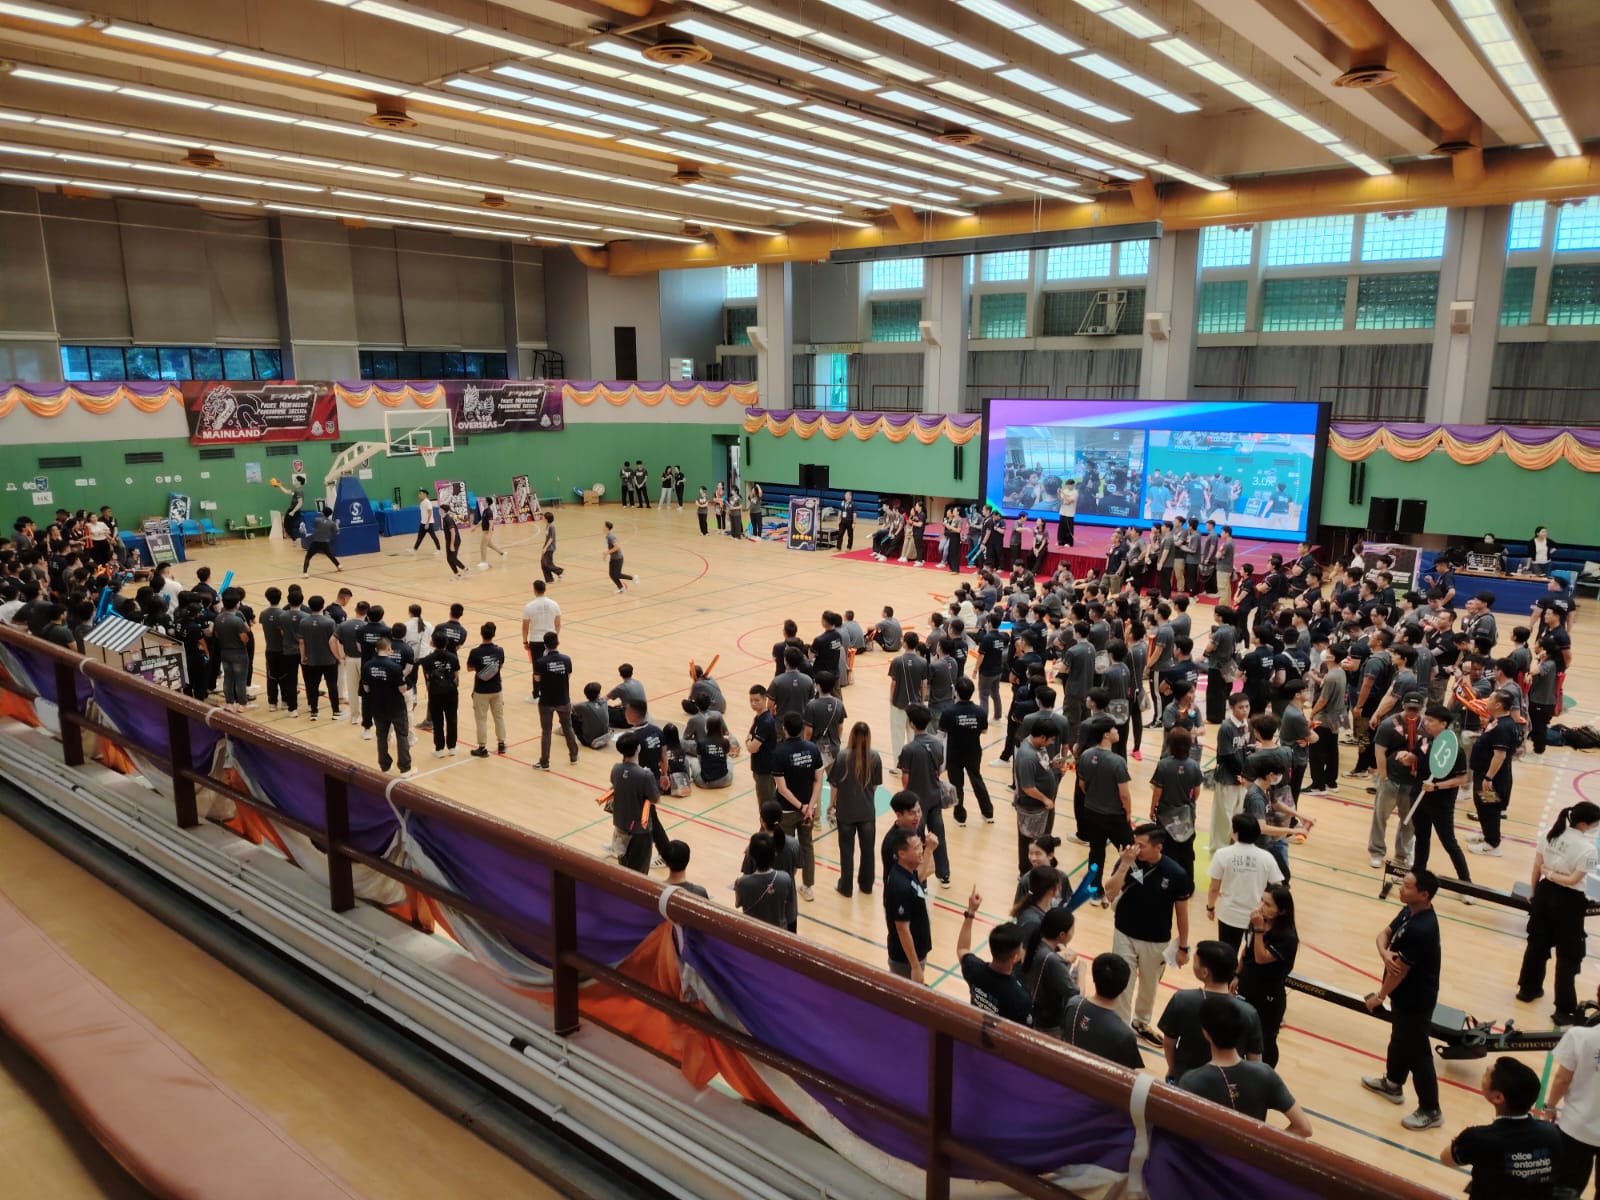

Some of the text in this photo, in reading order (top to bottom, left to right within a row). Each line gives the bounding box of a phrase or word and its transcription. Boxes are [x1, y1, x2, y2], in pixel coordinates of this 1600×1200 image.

[458, 421, 498, 430] OVERSEAS
[203, 429, 261, 439] MAINLAND
[1434, 739, 1452, 769] 13
